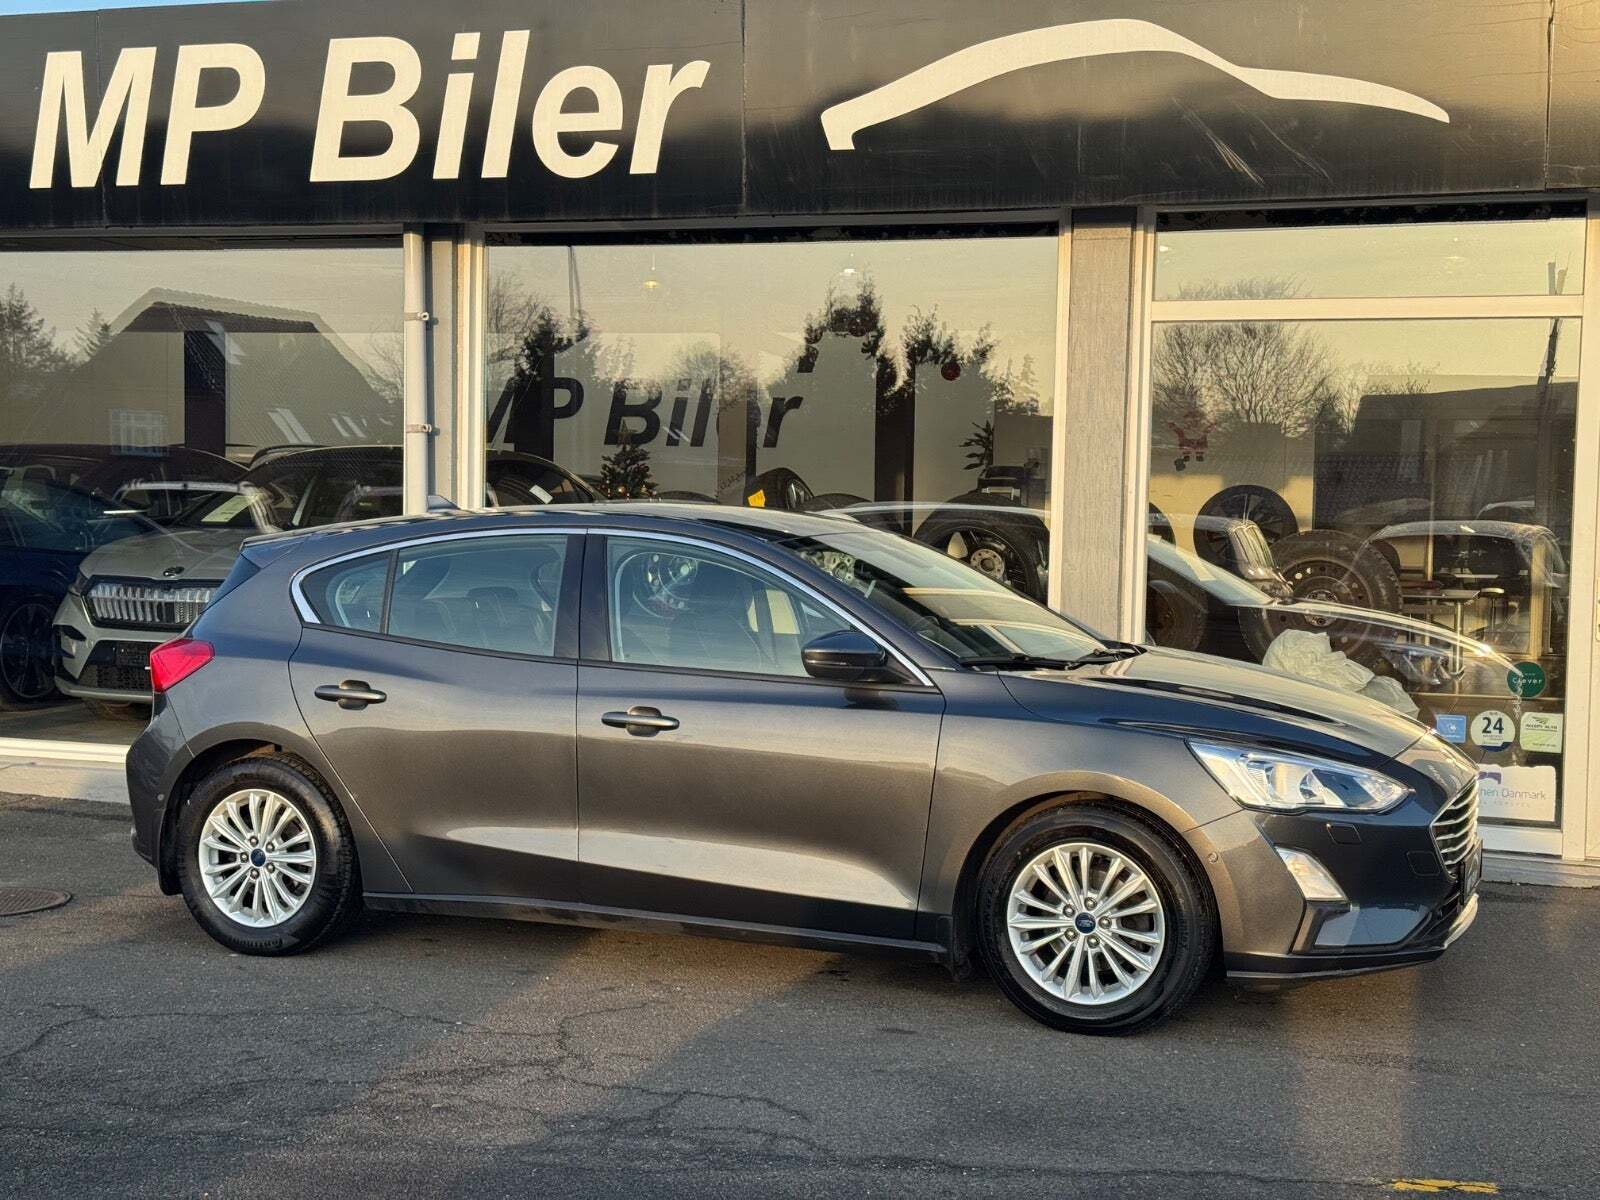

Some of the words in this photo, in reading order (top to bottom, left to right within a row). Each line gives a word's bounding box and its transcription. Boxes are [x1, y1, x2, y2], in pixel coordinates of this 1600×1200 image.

[29, 42, 266, 189] MP
[309, 29, 711, 183] Biler
[603, 376, 804, 449] Bilr
[1482, 717, 1505, 735] 24
[1501, 788, 1546, 800] Danmark
